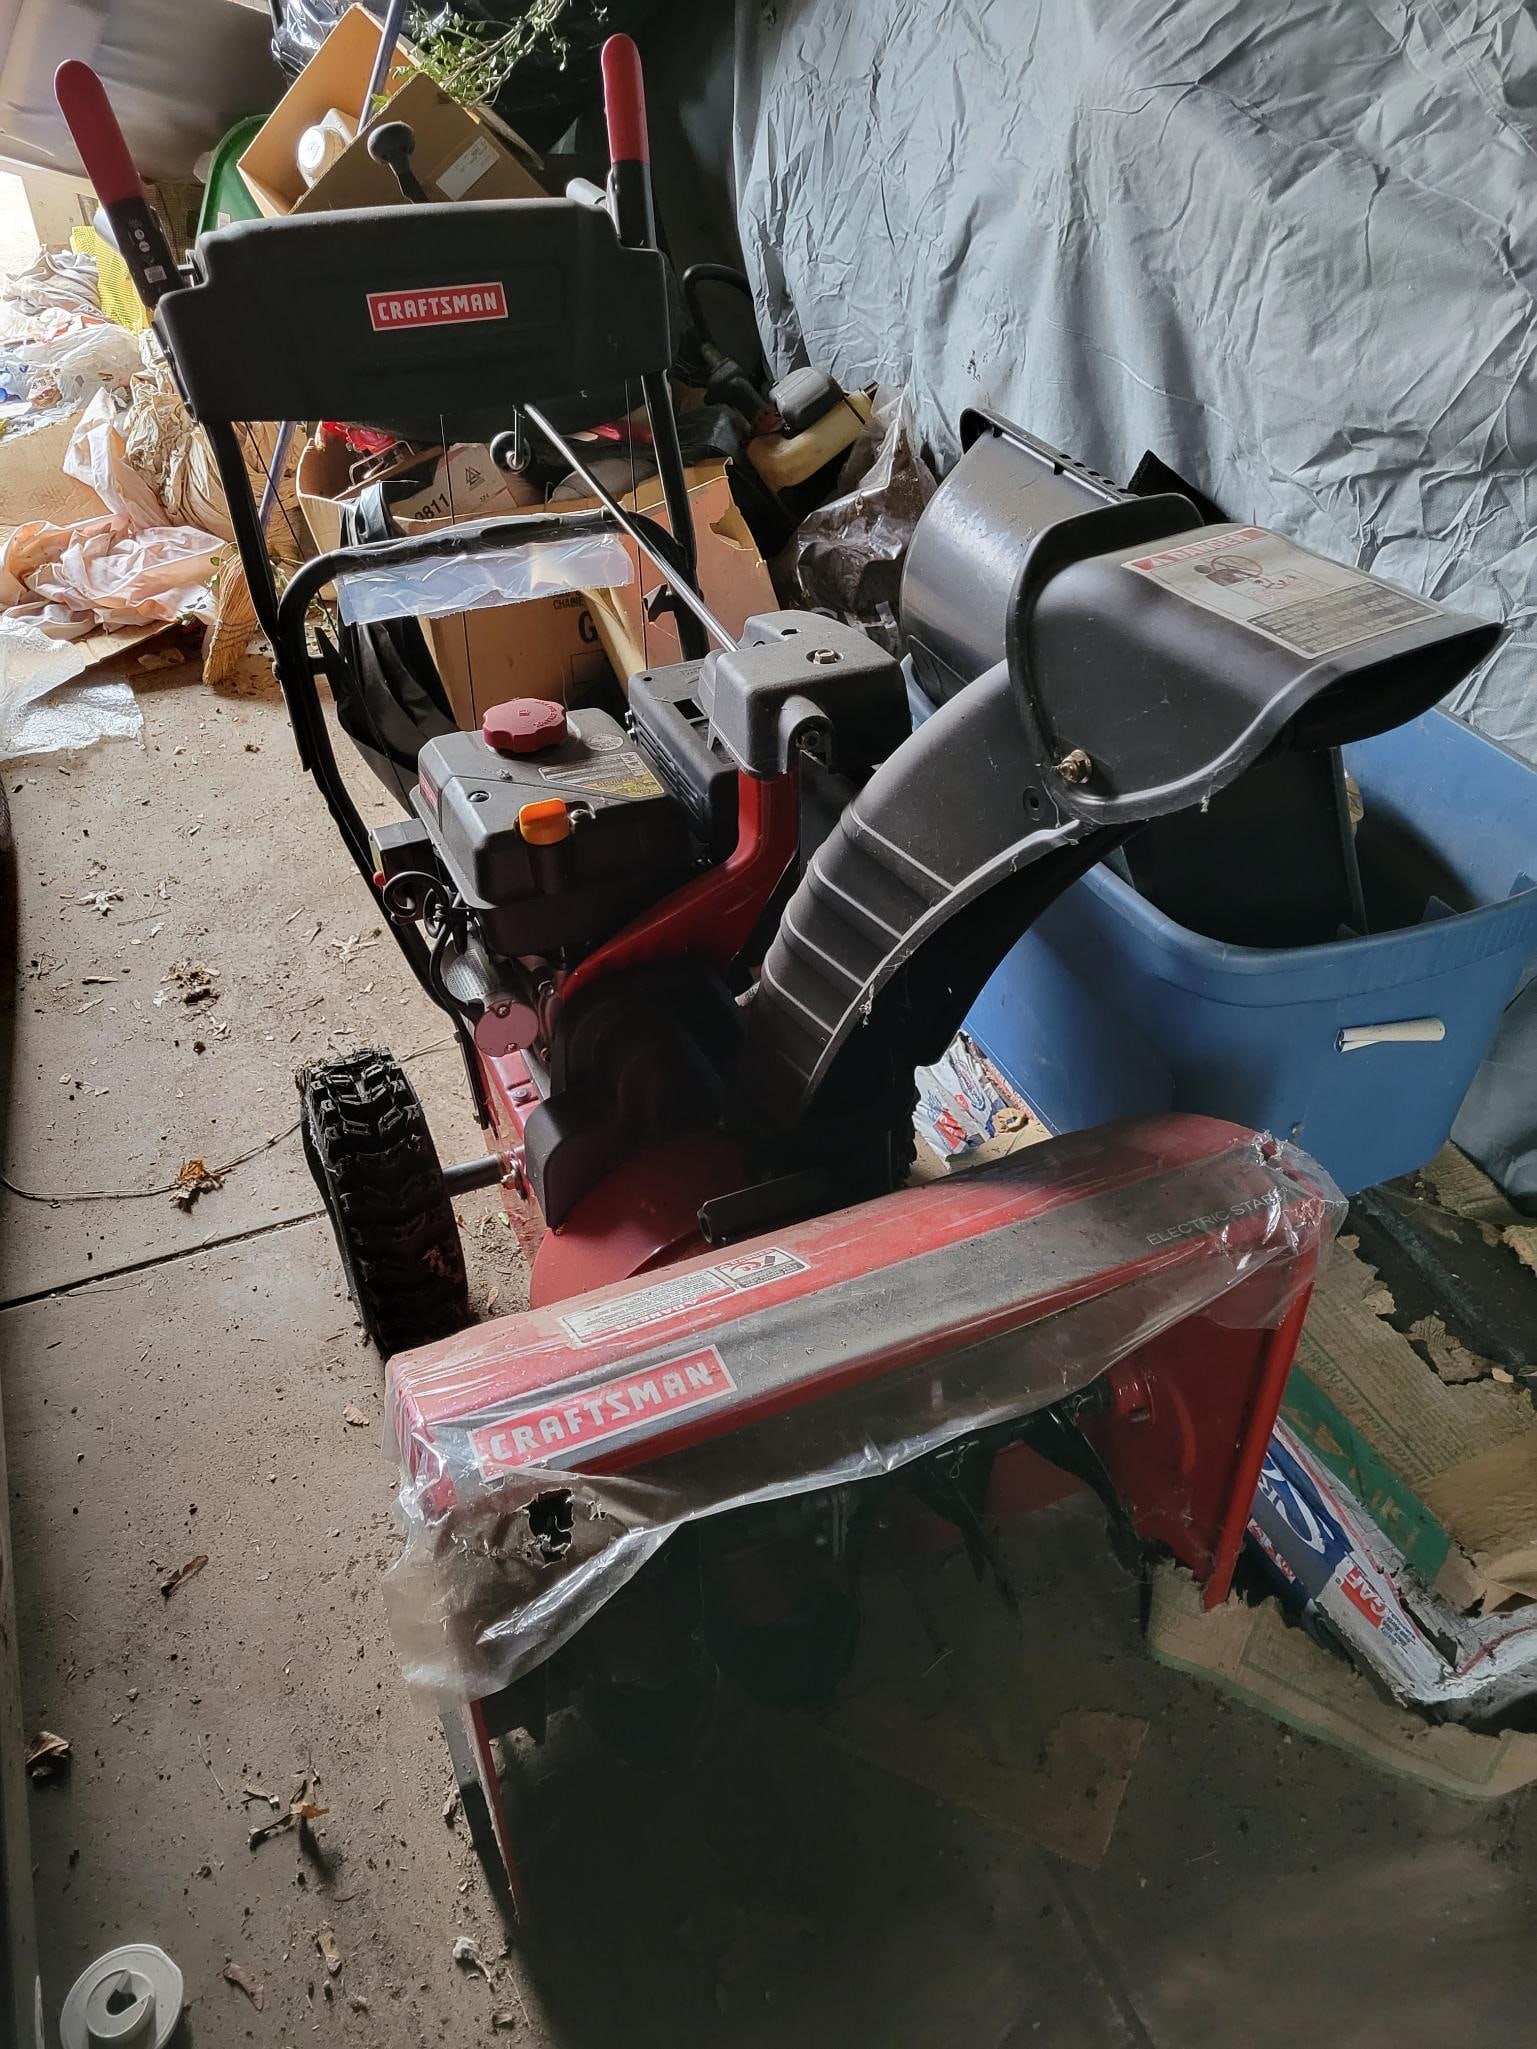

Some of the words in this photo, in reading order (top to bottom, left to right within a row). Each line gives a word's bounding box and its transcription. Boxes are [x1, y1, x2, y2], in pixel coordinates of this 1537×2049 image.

[377, 292, 497, 321] CRAFTSMAN
[1170, 531, 1252, 561] DANGER
[1146, 1209, 1230, 1247] ELECTRIC
[488, 1362, 714, 1462] CRAFTSMAN
[1342, 1566, 1390, 1618] GAF
